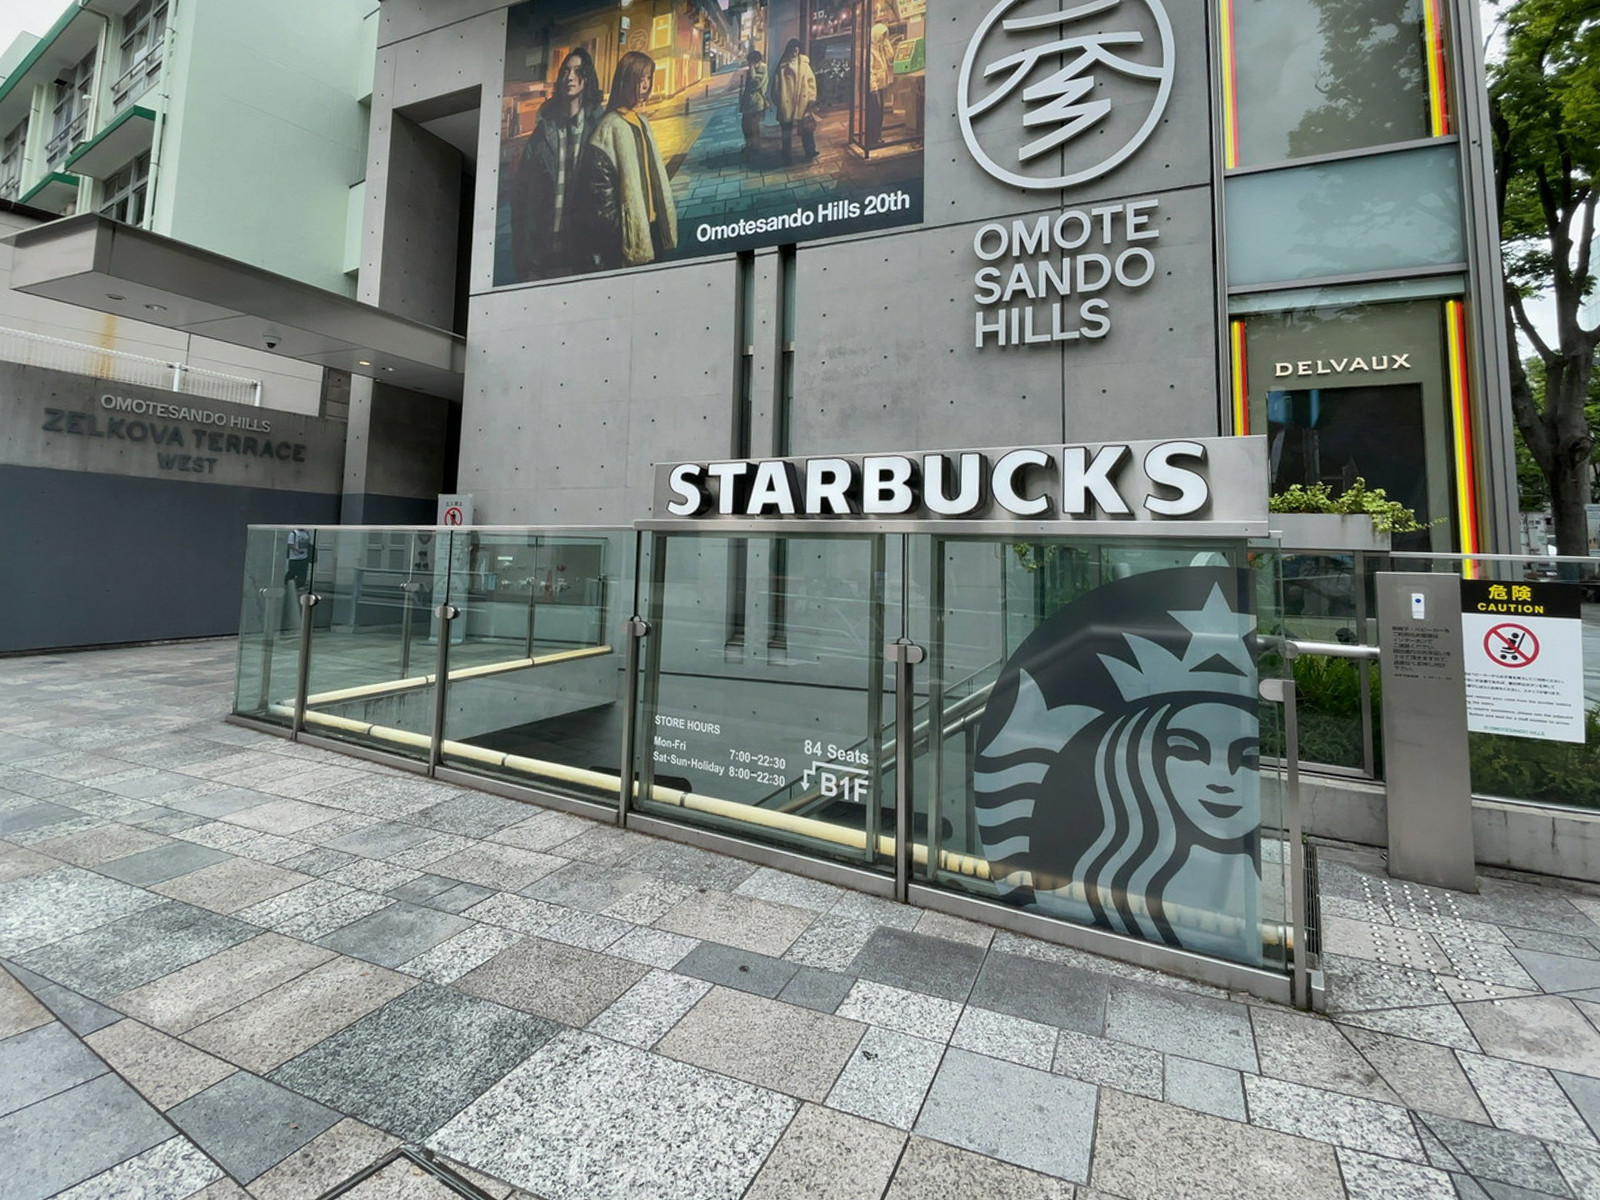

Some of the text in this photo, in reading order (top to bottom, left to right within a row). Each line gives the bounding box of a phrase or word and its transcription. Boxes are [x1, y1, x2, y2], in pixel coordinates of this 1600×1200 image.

[697, 191, 911, 242] Omotesando Hills 20th
[973, 198, 1160, 262] OMOTE
[973, 246, 1156, 305] SANDO
[974, 298, 1112, 349] HILLS
[1274, 353, 1412, 378] DELVAUX
[100, 394, 271, 433] OMOTESANDO HILLS
[42, 407, 307, 463] ZELKOVA TERRACE
[157, 451, 217, 475] WEST
[665, 440, 1211, 518] STARBUCKS
[1477, 602, 1545, 614] CAUTION
[1488, 584, 1532, 602] 危険
[654, 714, 721, 735] STORE HOURS
[803, 739, 870, 765] 84 Seats
[819, 771, 868, 802] B1F
